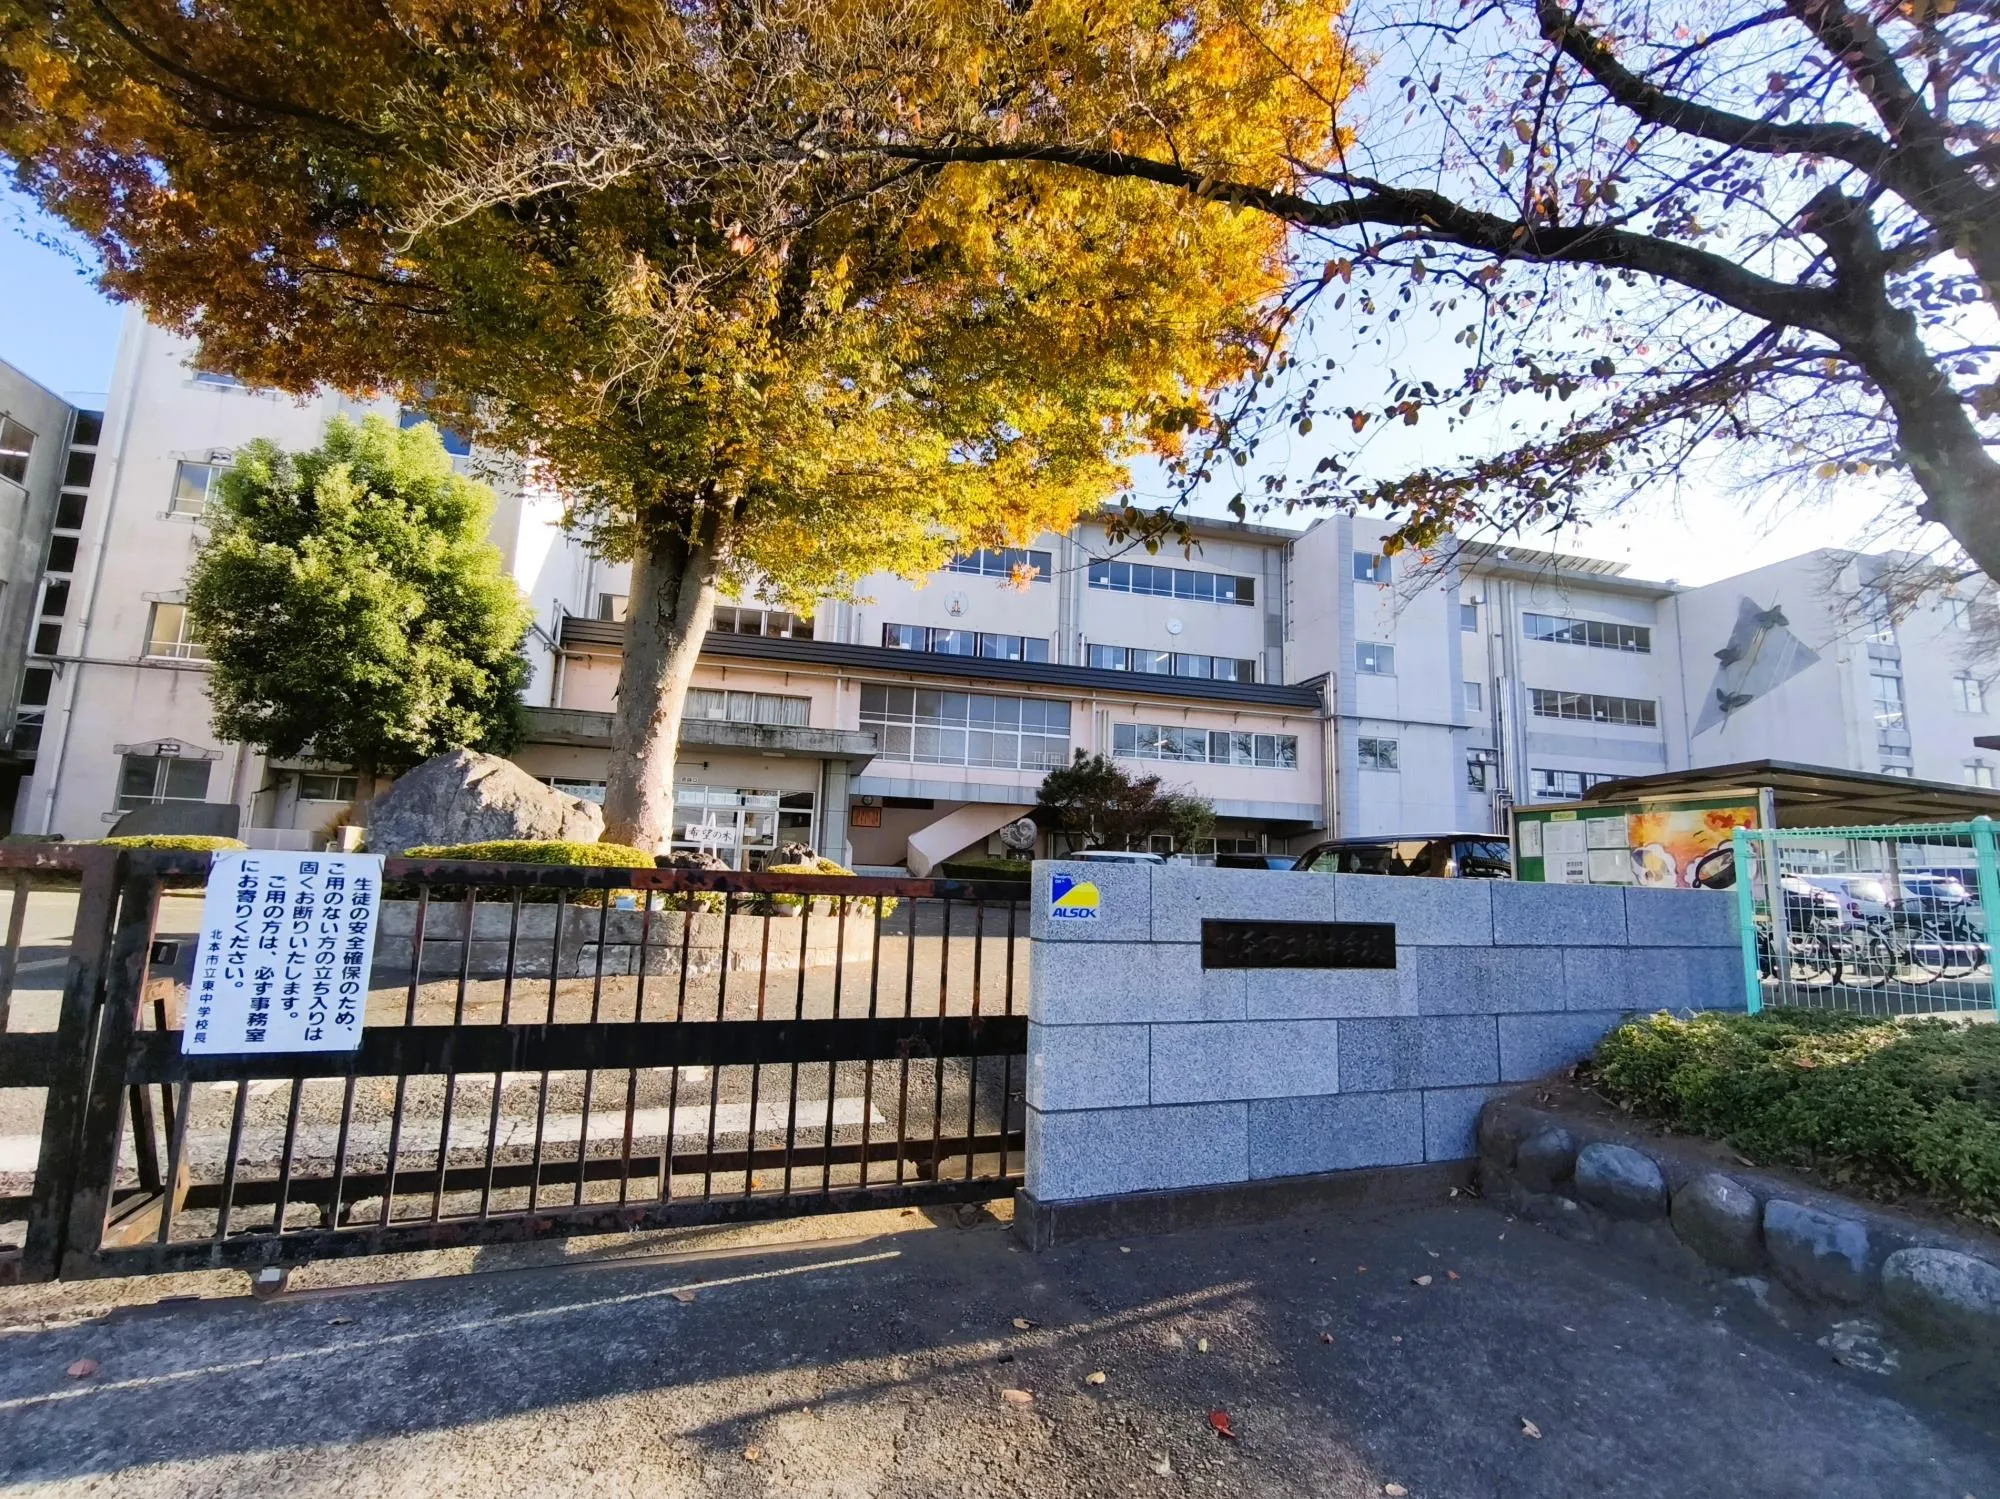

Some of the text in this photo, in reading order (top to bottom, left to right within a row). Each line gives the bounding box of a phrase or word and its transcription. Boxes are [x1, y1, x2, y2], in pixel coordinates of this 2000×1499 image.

[224, 859, 260, 988] にお寄りください。
[281, 861, 319, 1019] 固くお断りいたします。
[304, 862, 345, 1041] ご用のない方の立ち入りは
[334, 876, 373, 1032] 生徒の安全確保のため、
[1052, 907, 1096, 918] ALSOK
[193, 928, 223, 1044] 北本市立東中学校長
